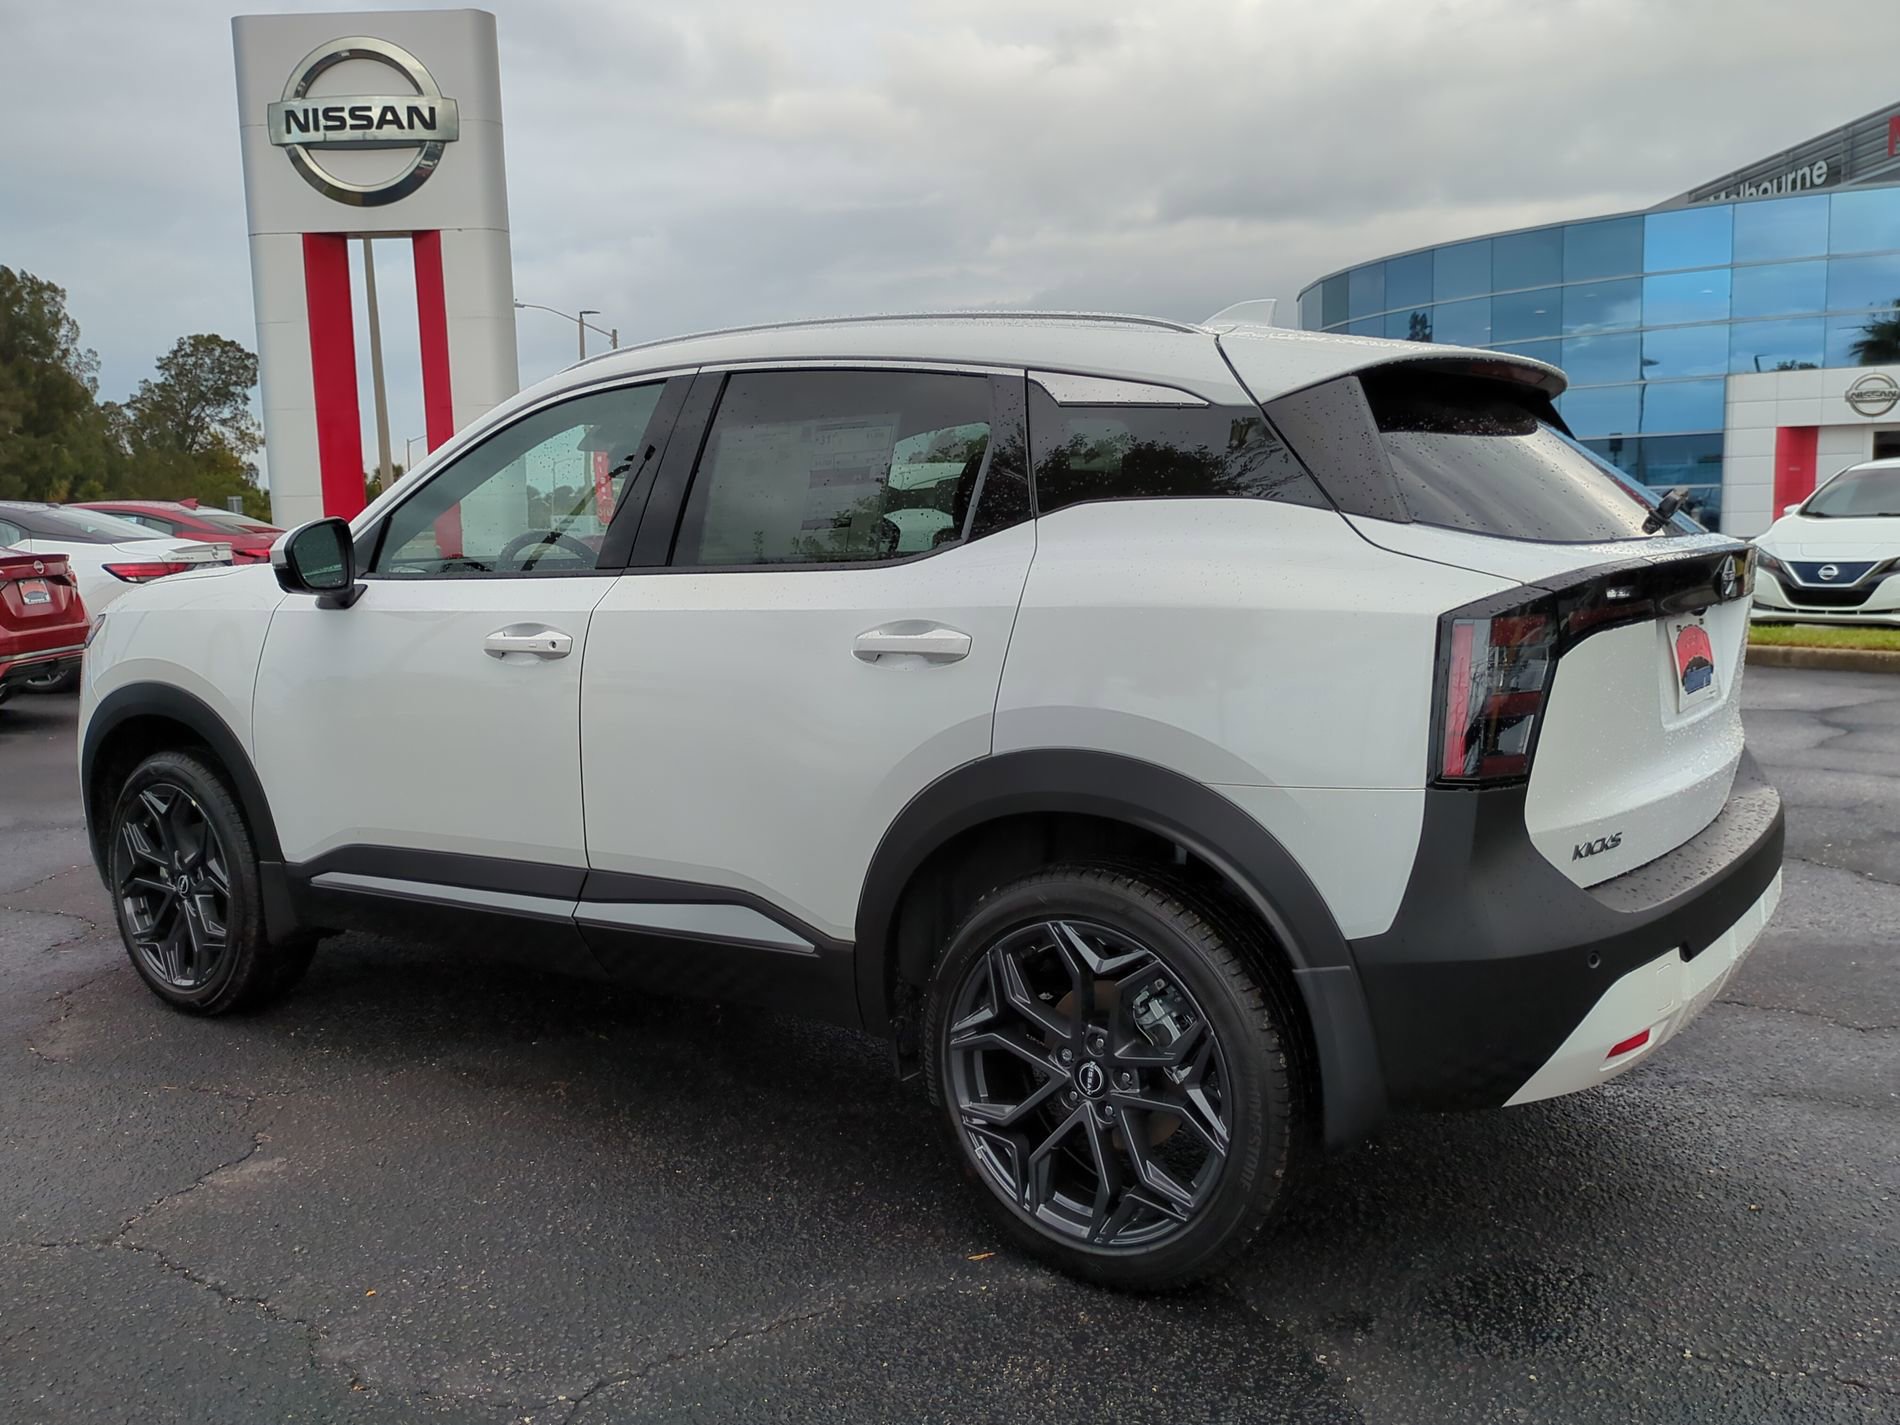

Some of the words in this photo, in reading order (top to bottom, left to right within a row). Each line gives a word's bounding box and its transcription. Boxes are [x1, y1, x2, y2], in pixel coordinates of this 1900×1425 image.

[284, 105, 437, 134] NISSAN
[1708, 160, 1828, 201] lbourne
[1850, 390, 1897, 400] NISSAN
[1572, 832, 1622, 862] KICKS
[1086, 1060, 1096, 1096] NISSAN
